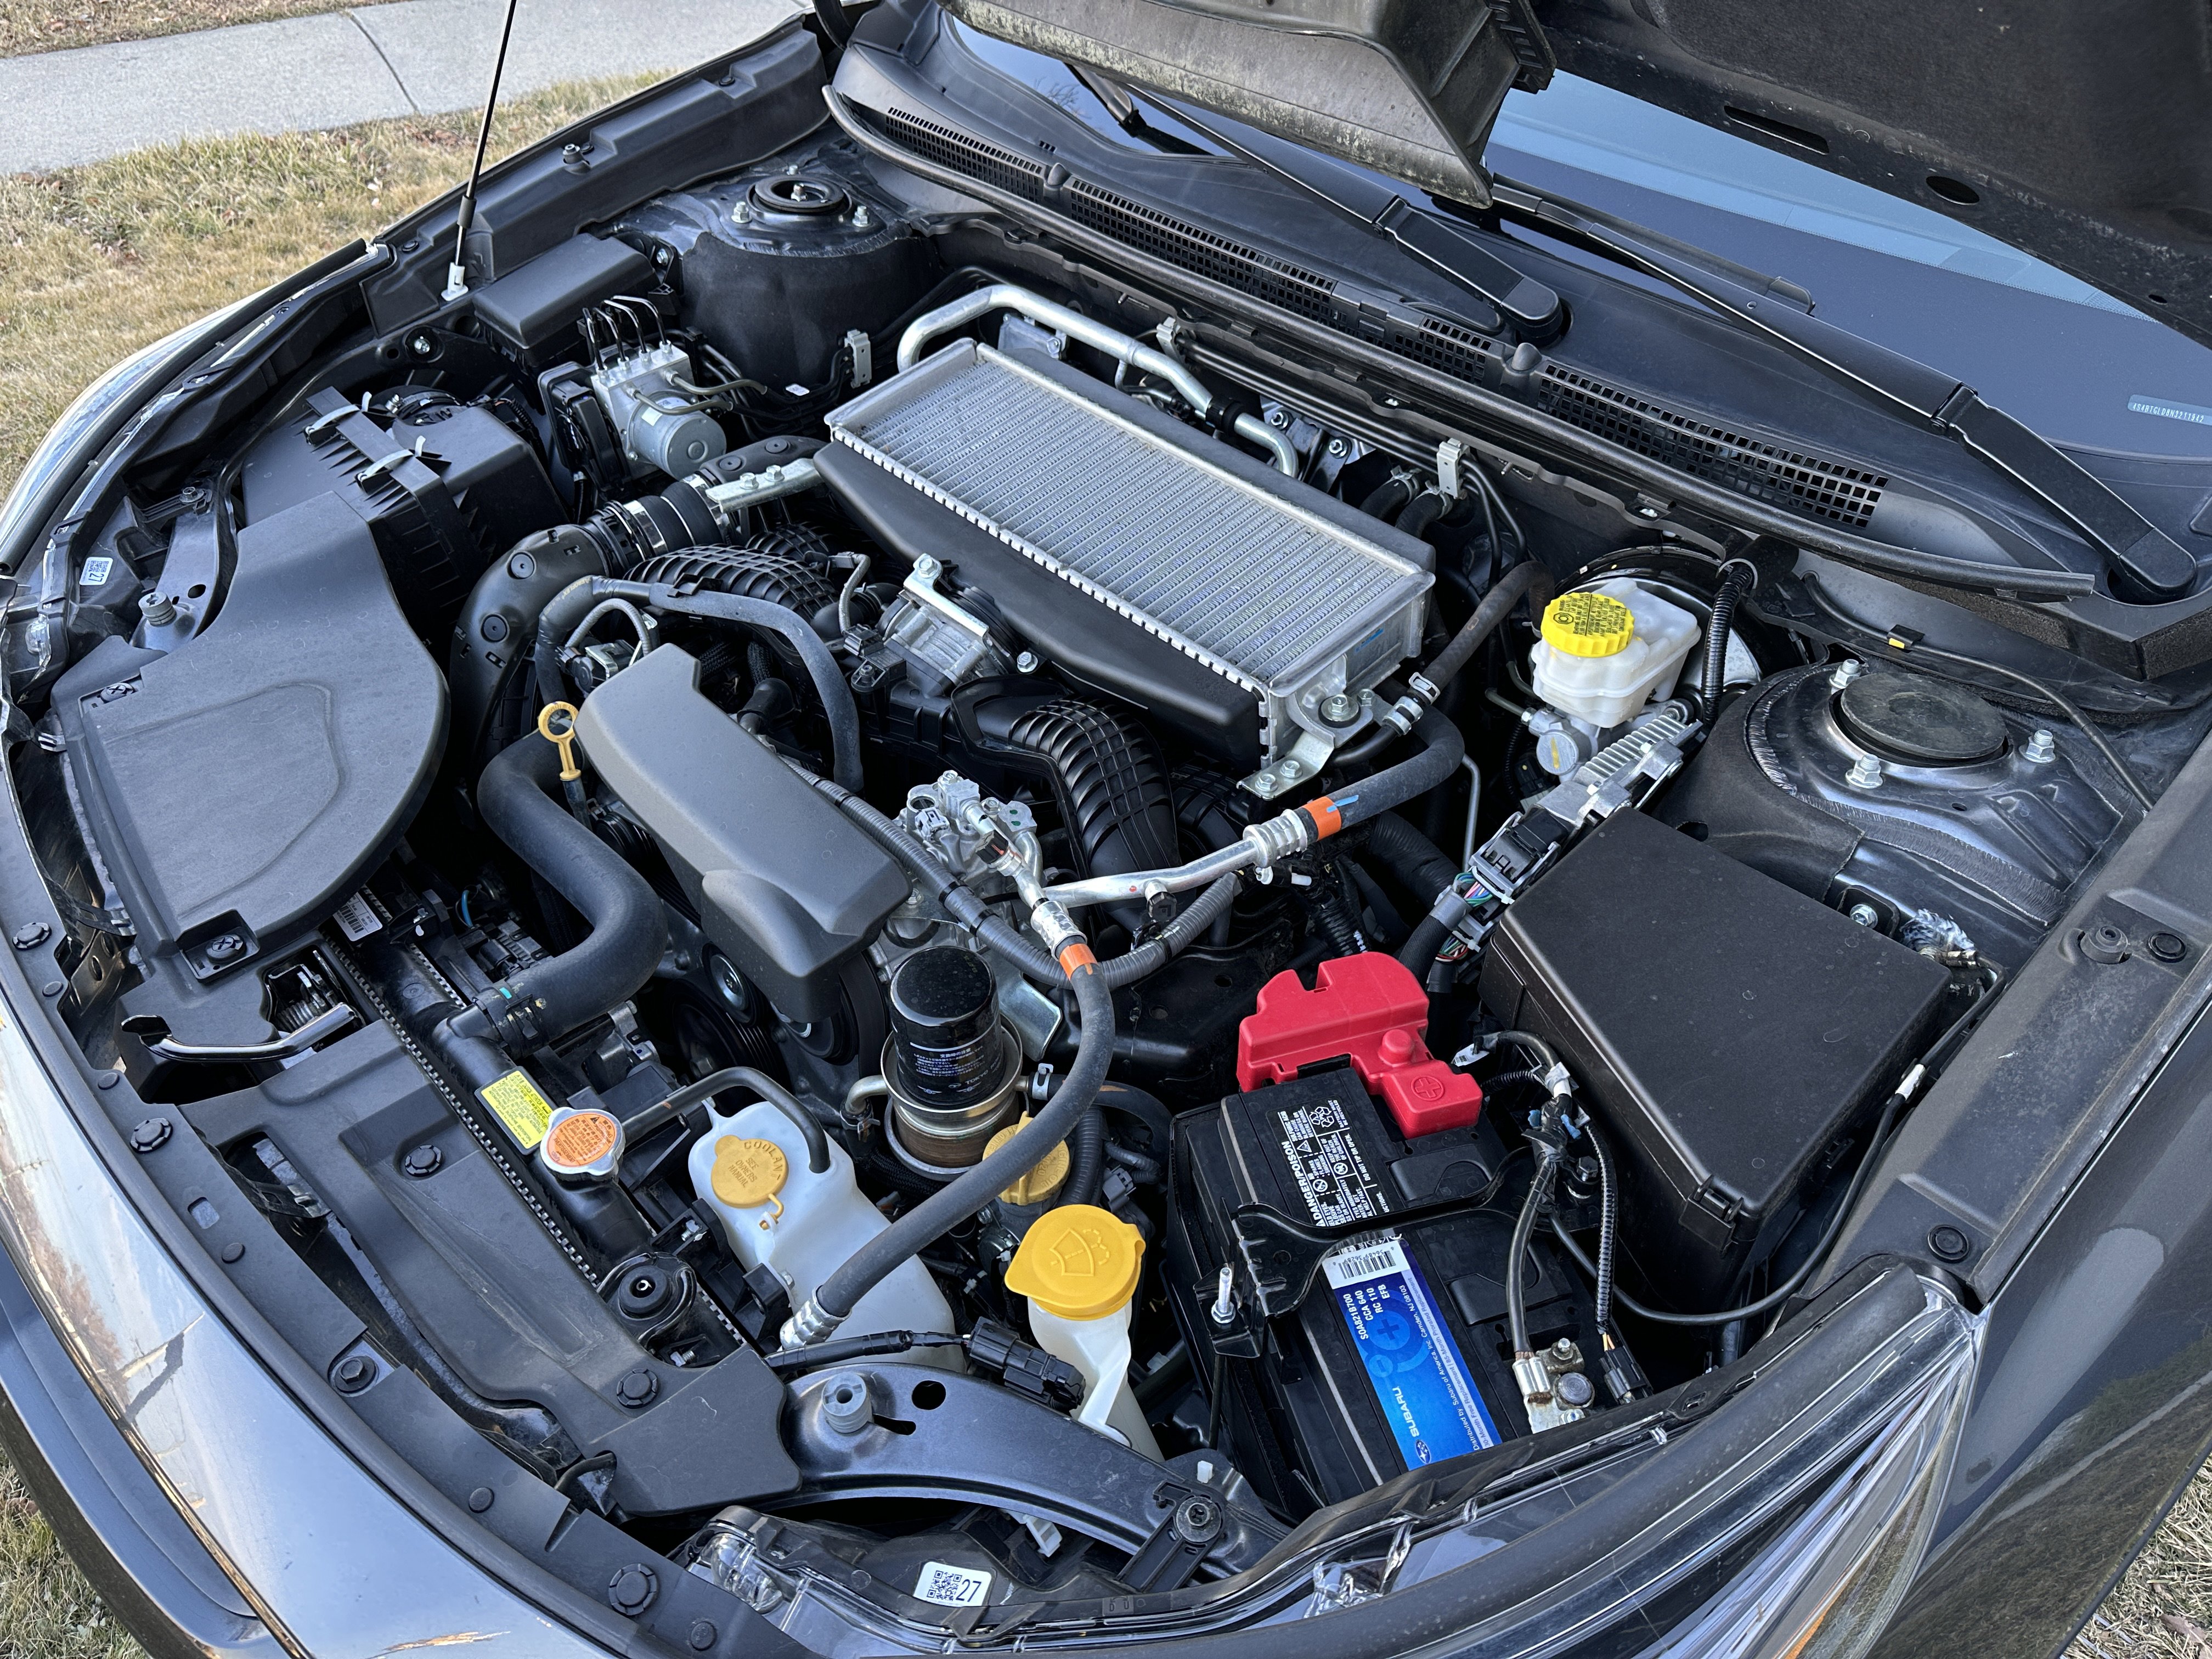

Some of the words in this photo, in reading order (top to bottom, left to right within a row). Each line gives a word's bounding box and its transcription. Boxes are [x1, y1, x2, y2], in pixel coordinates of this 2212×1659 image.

[88, 573, 104, 582] 27
[1279, 1110, 1289, 1121] ACID
[1284, 1121, 1298, 1142] SULFURIC
[1290, 1119, 1300, 1132] CAUSE
[1295, 1131, 1304, 1140] CAN
[1343, 1133, 1355, 1148] OPEN.
[552, 1137, 575, 1163] AVERTISSEMENT
[1323, 1143, 1331, 1152] OUT
[1327, 1139, 1338, 1153] REACH
[744, 1141, 784, 1181] COOLANT
[746, 1157, 759, 1170] SEE
[1327, 1152, 1336, 1163] KEEP
[1333, 1153, 1341, 1161] THE
[1353, 1154, 1362, 1163] TIP
[735, 1160, 758, 1183] OWNERS
[1357, 1163, 1367, 1173] NOT
[728, 1164, 749, 1188] MANUAL
[1040, 1175, 1059, 1188] OIL
[1280, 1140, 1323, 1220] DANGER/POISON
[1362, 1172, 1371, 1181] DO
[1339, 1179, 1356, 1207] IMMEDIATELY
[1352, 1194, 1361, 1203] GET
[1334, 1204, 1342, 1214] CAN
[1361, 1199, 1370, 1210] HELP
[1327, 1205, 1341, 1225] PLOSIVE
[1338, 1214, 1347, 1223] SES
[1352, 1206, 1361, 1218] EYES
[1354, 1290, 1367, 1305] 640
[1365, 1287, 1378, 1301] 110
[1377, 1284, 1390, 1299] EFB
[1398, 1284, 1411, 1302] 08103
[1407, 1277, 1429, 1311] Replacement
[1361, 1305, 1374, 1321] CCA
[1372, 1302, 1384, 1313] RC
[1407, 1302, 1416, 1311] NJ
[1411, 1311, 1429, 1338] Camden,
[1423, 1312, 1438, 1335] Prorated
[1435, 1336, 1452, 1363] 85-Month
[1429, 1350, 1446, 1375] America,
[1448, 1366, 1471, 1404] Replacement
[1444, 1383, 1459, 1405] Subaru
[1392, 1386, 1420, 1437] SUBARU
[1466, 1404, 1477, 1418] Free
[1459, 1417, 1480, 1451] Distributed
[955, 1579, 982, 1602] 27
[1109, 1603, 1115, 1612] D
[1124, 1600, 1130, 1610] U
